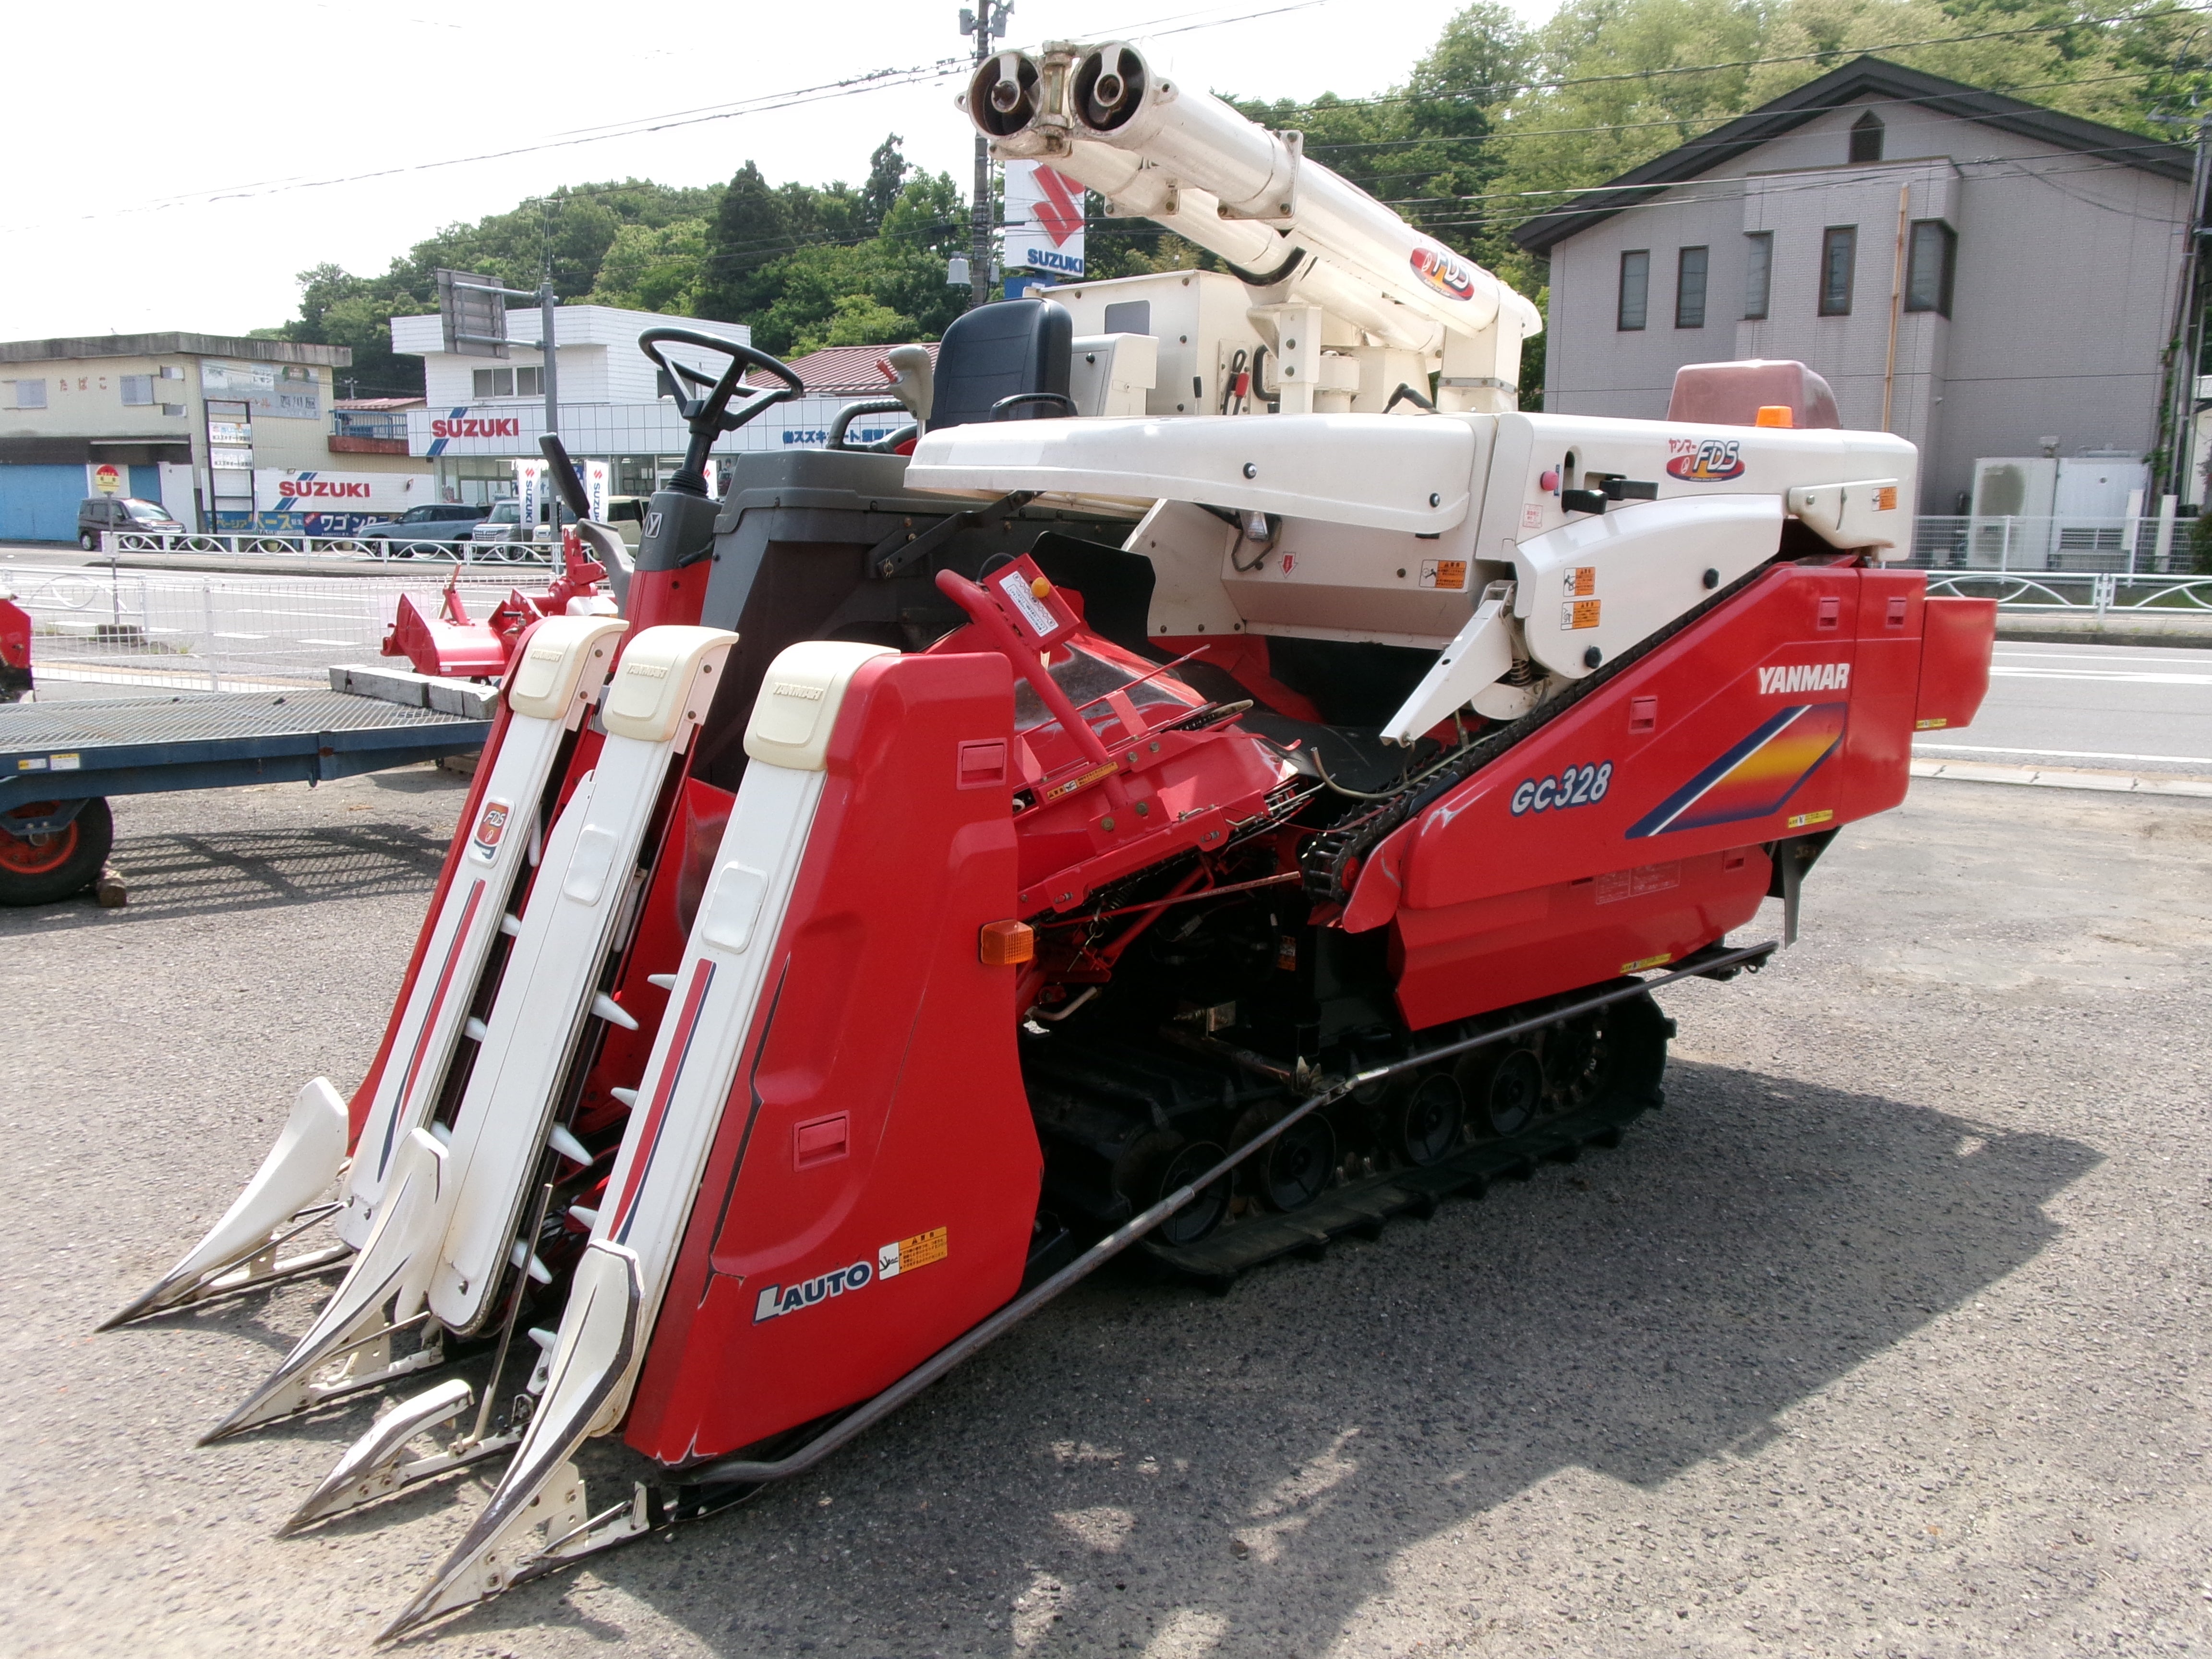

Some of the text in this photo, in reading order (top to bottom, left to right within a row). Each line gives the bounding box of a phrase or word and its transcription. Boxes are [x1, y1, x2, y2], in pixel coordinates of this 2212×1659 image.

[1027, 248, 1083, 273] SUZUKI
[432, 418, 519, 438] SUZUKI
[1668, 438, 1740, 473] ヤンマー FDS
[279, 481, 370, 497] SUZUKI
[1757, 662, 1850, 695] YANMAR
[1512, 761, 1612, 815] GC328
[483, 810, 506, 827] FDS
